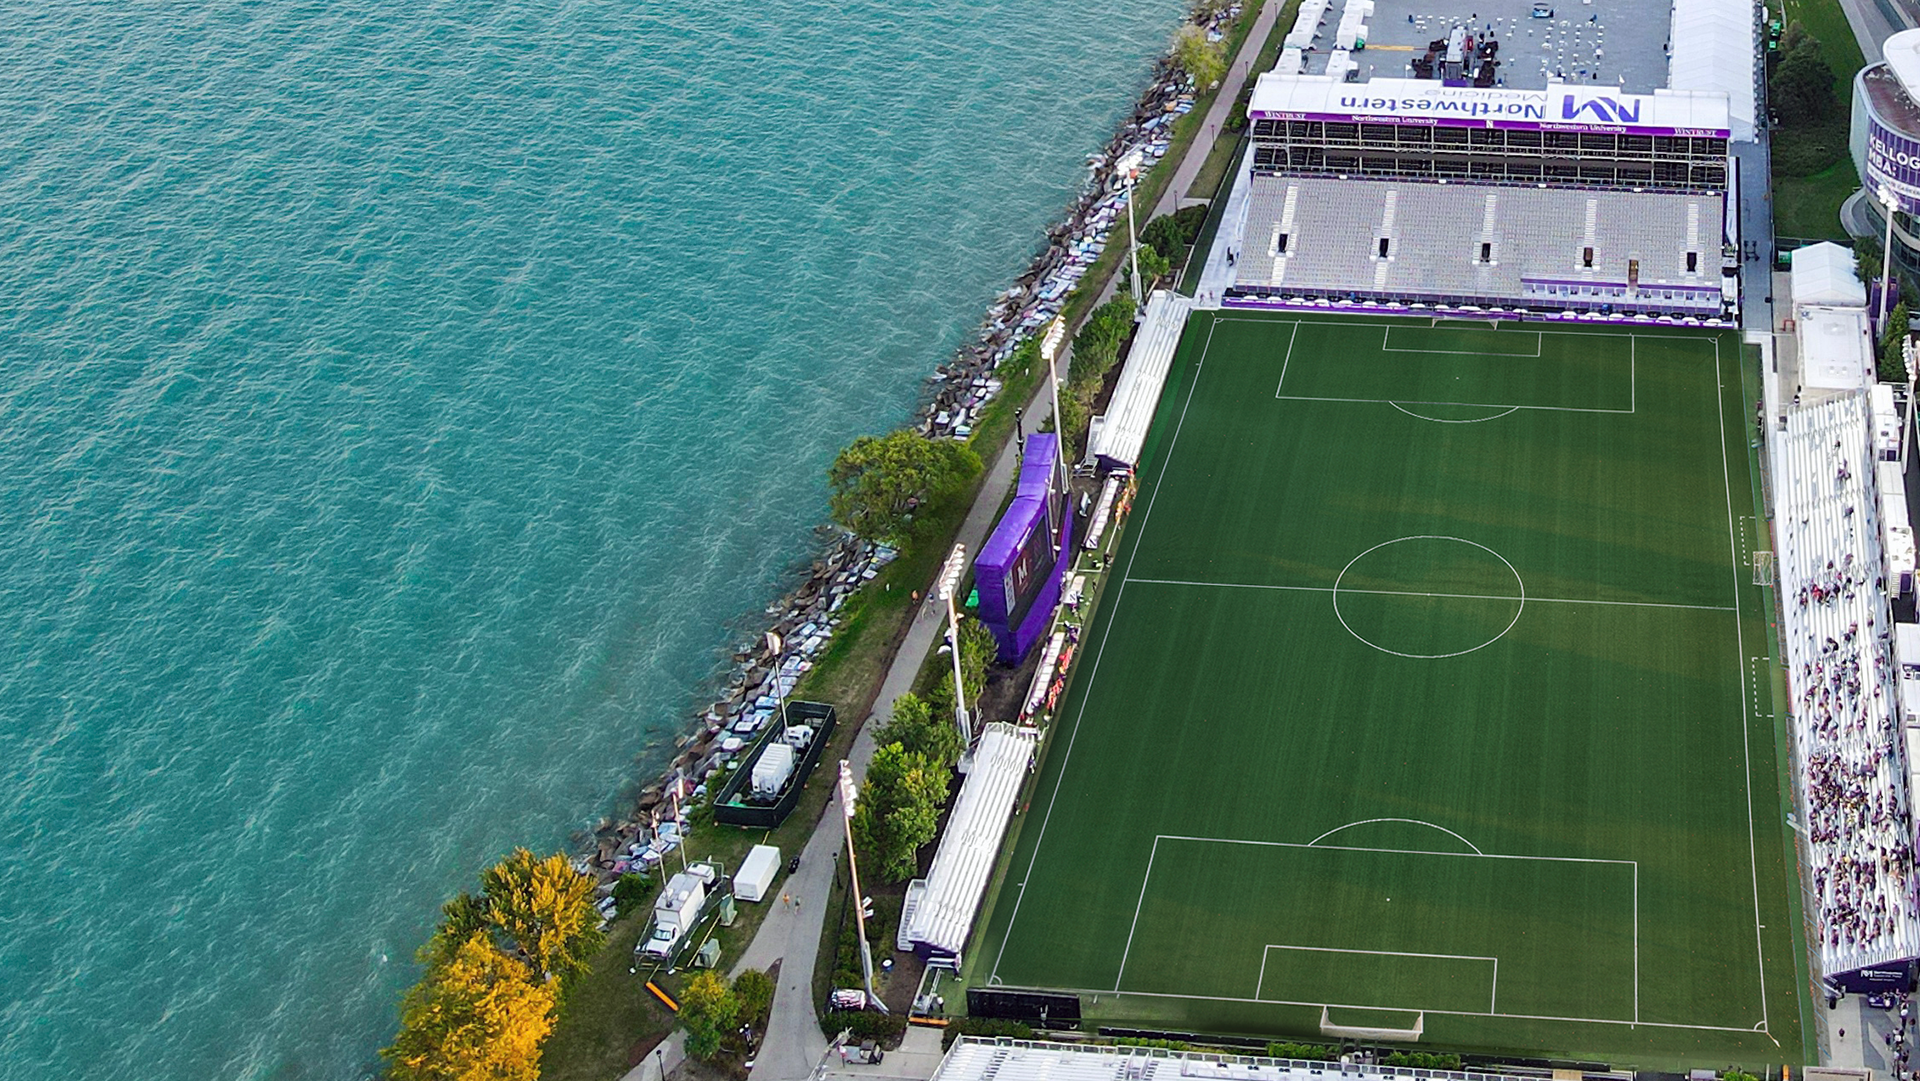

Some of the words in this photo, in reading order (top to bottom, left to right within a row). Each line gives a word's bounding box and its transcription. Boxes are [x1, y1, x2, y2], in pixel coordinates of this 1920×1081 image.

[1340, 97, 1544, 119] Northwestern
[1351, 115, 1400, 123] Northwestern
[1402, 116, 1439, 126] University
[1486, 120, 1494, 129] N
[1539, 122, 1588, 131] Northwestern
[1590, 125, 1627, 133] University
[1869, 148, 1896, 177] MBA:
[1017, 557, 1028, 586] M
